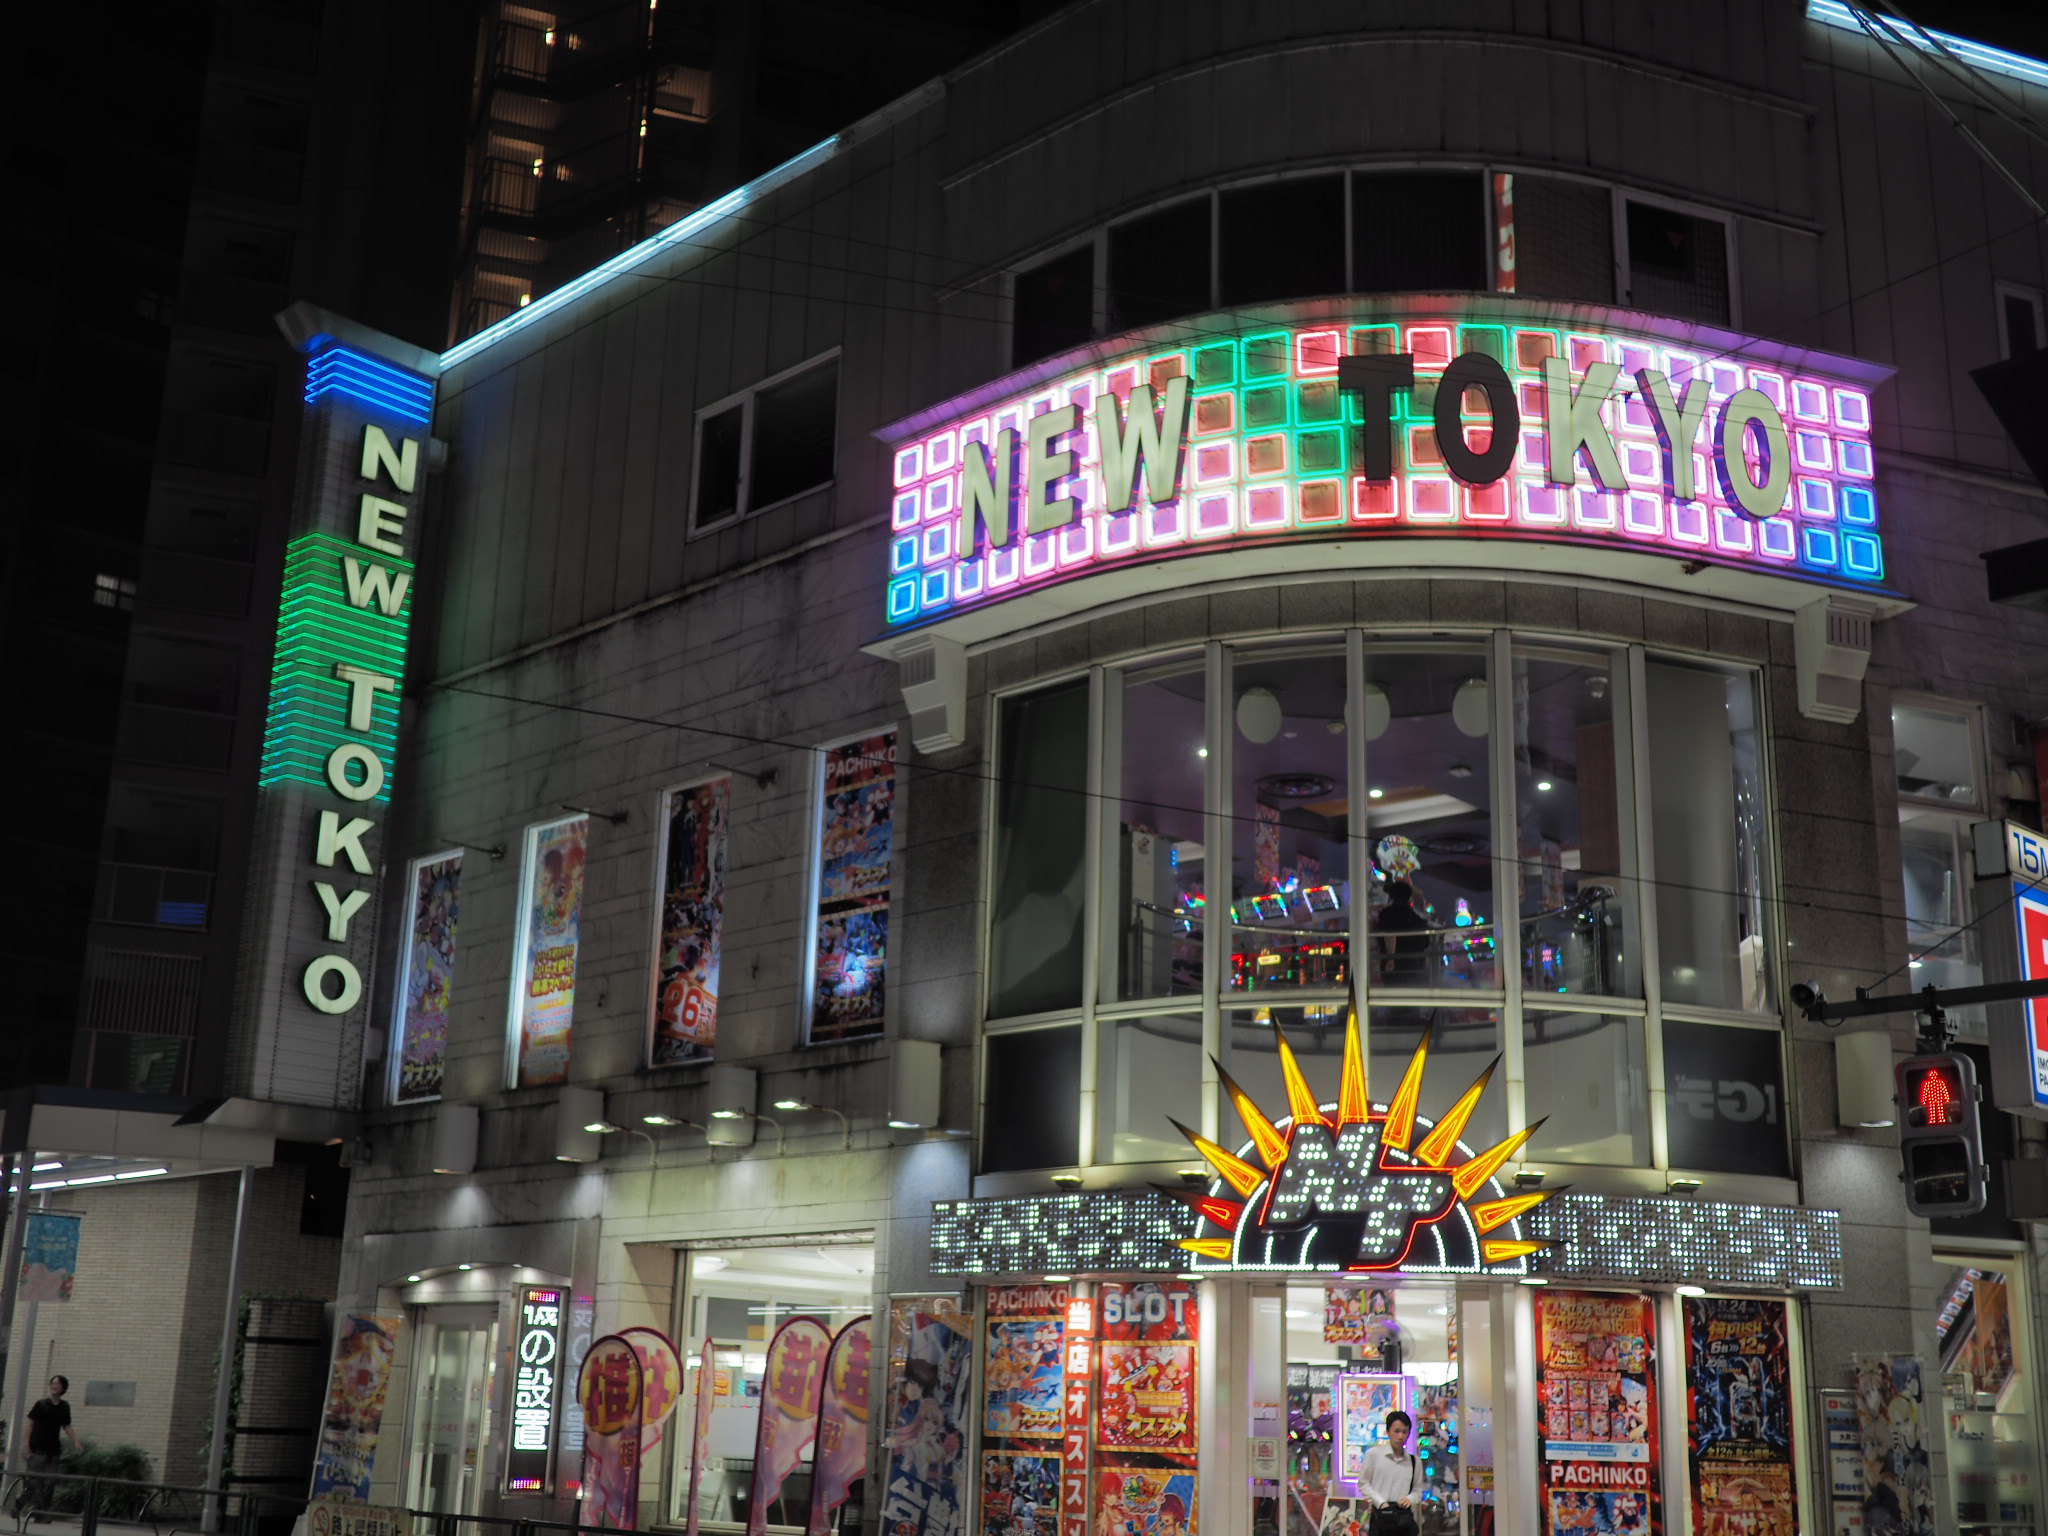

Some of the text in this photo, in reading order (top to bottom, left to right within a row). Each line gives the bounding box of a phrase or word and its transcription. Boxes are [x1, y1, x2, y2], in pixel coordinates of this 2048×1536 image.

[960, 352, 1791, 560] NEW TOKYO
[303, 423, 419, 1015] NEW TOKYO
[826, 746, 897, 779] PACHINKO
[662, 981, 703, 1027] 26
[987, 1289, 1068, 1309] PACHINKO
[1103, 1292, 1189, 1324] SLOT
[1125, 1411, 1189, 1440] オススメ
[1550, 1465, 1647, 1485] PACHINKO
